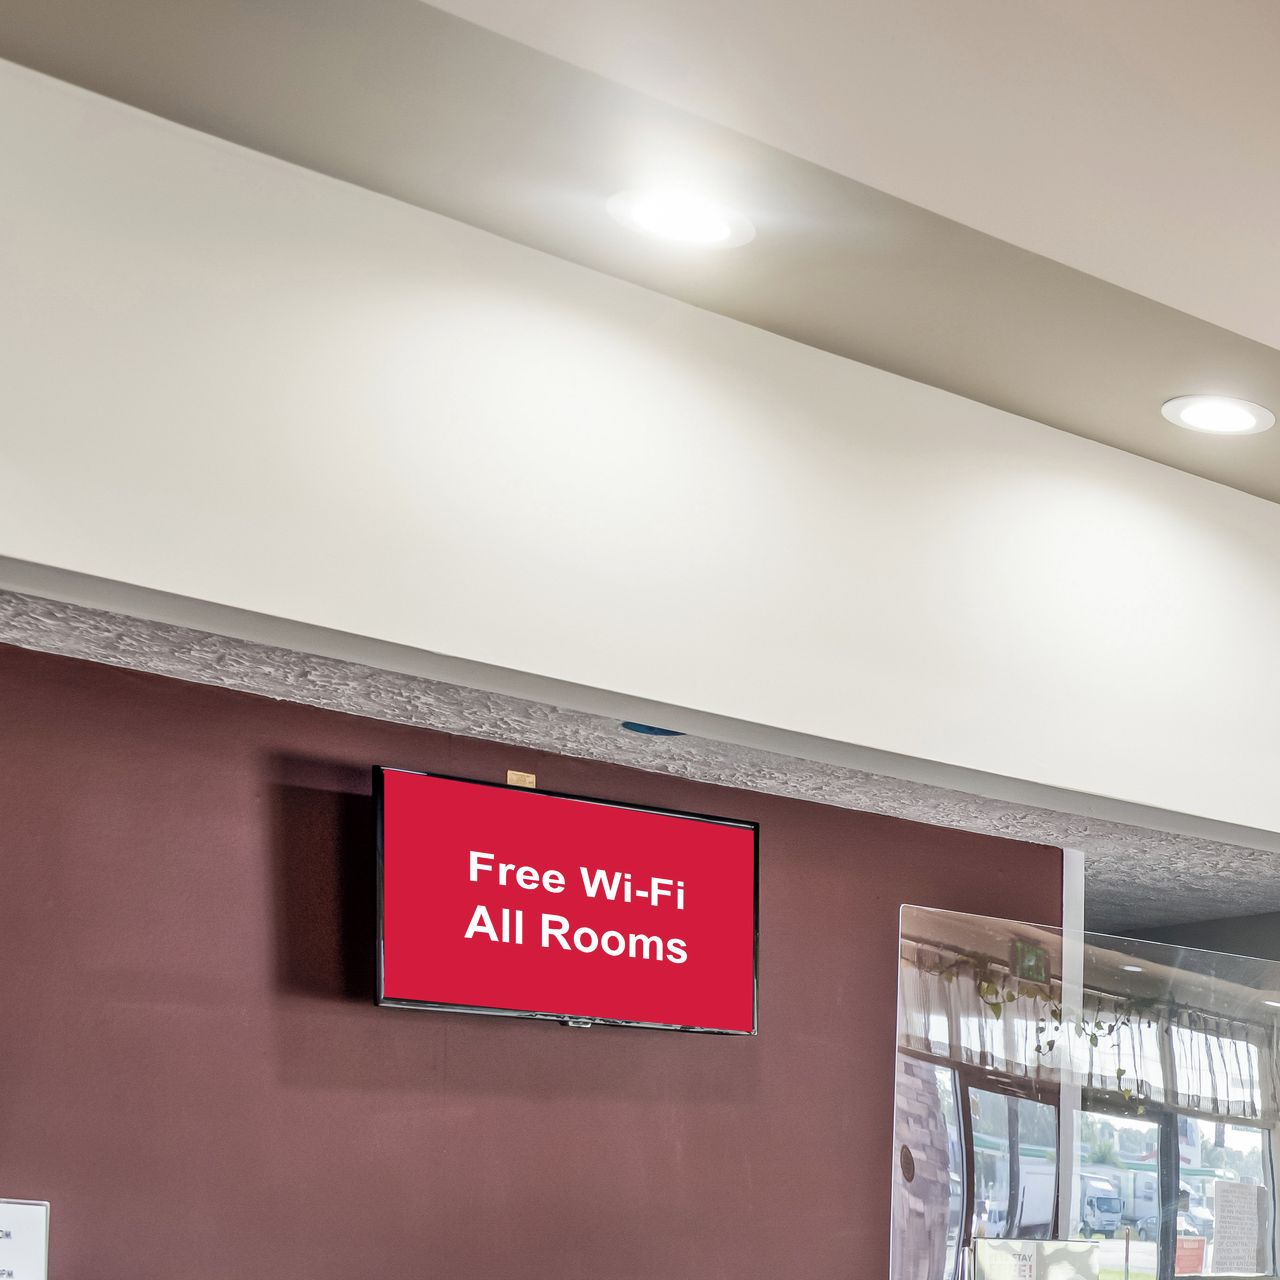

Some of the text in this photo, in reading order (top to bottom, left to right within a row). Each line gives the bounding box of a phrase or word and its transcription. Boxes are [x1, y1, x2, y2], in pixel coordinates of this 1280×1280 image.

[468, 850, 686, 910] Free Wi-Fi
[464, 904, 689, 964] All Rooms
